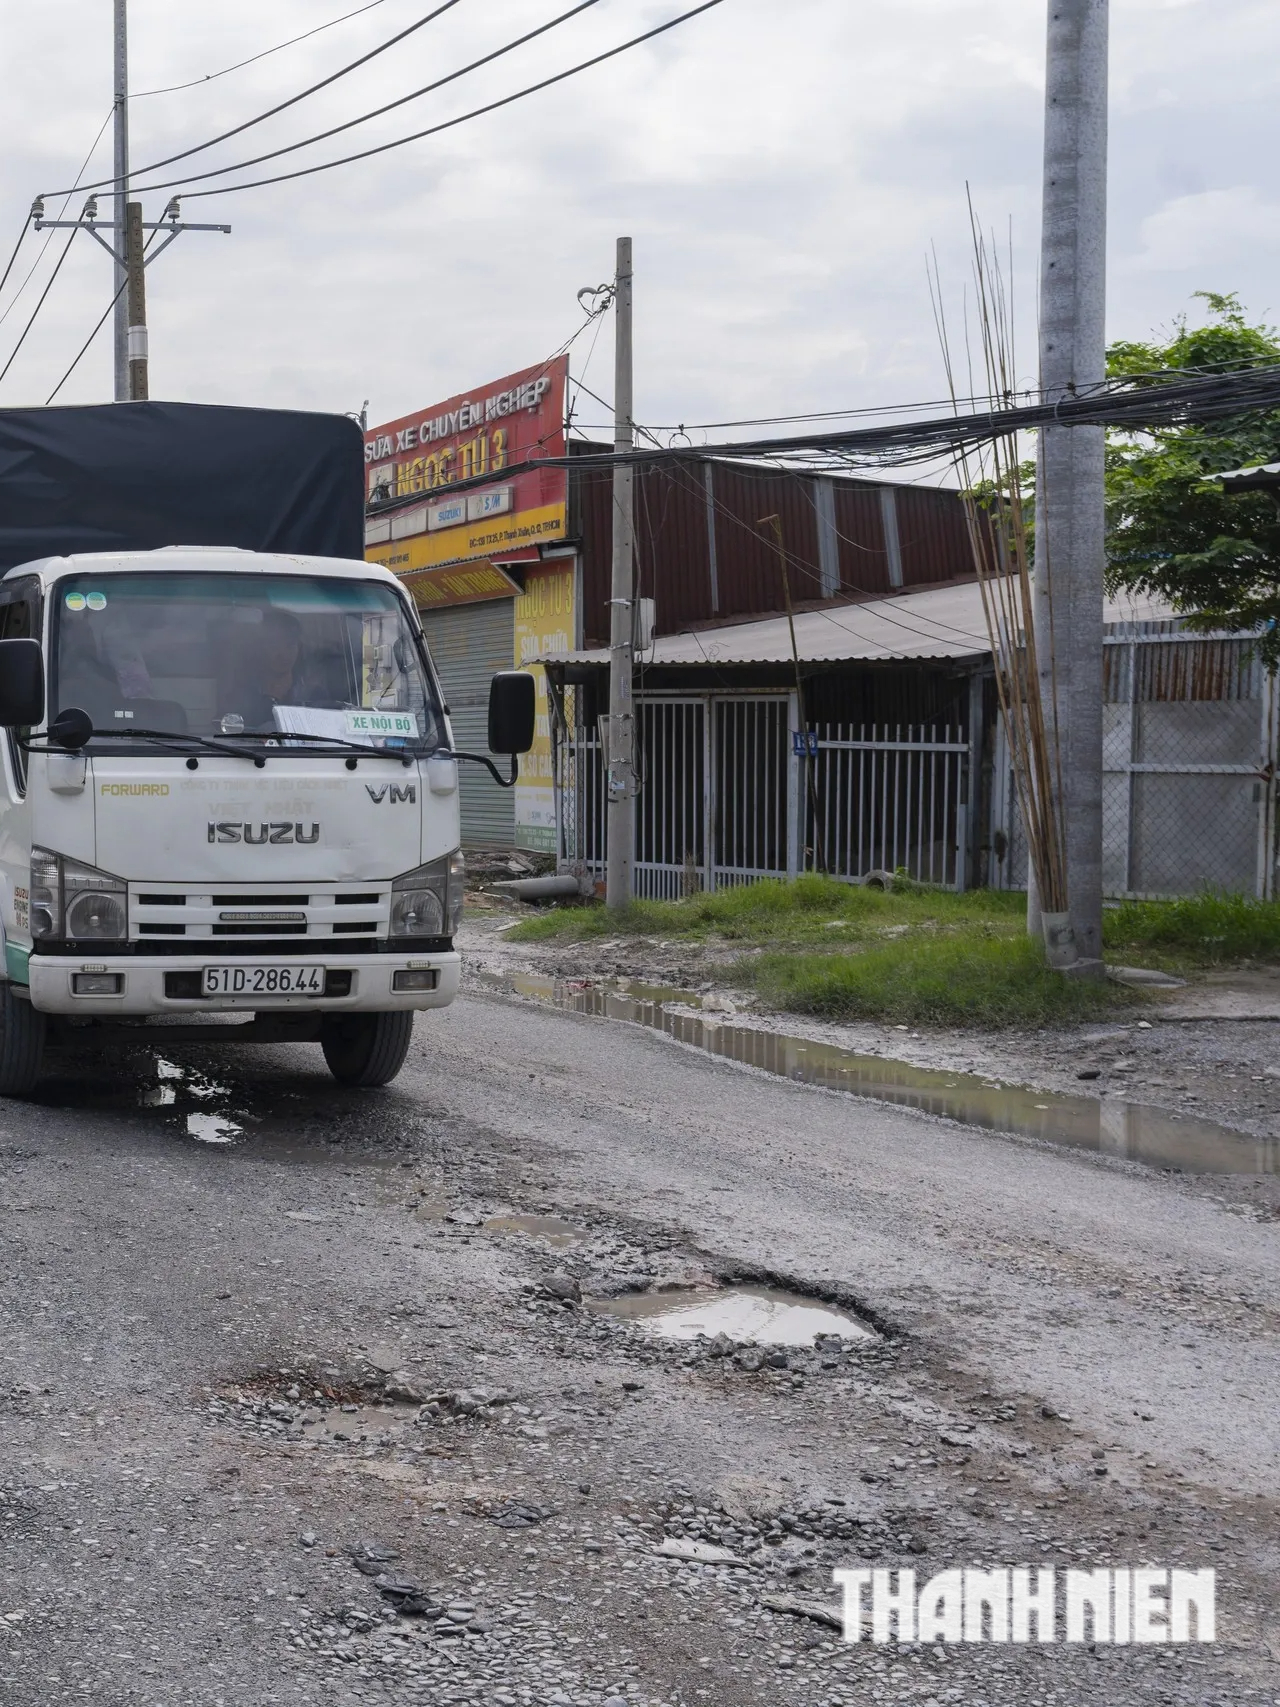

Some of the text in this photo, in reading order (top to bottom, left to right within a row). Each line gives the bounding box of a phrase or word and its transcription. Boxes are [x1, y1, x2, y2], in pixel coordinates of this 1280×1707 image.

[364, 377, 551, 463] SỬA XE CHUYÊN NGHIỆP
[458, 427, 488, 480] TÚ
[492, 428, 507, 471] 3
[438, 507, 462, 522] SUZUKI
[565, 572, 572, 615] 3
[352, 716, 411, 734] XE NỘI BỘ
[101, 783, 170, 797] FORWARD
[364, 783, 417, 804] VM
[207, 821, 320, 844] ISUZU
[207, 968, 320, 991] 51D-286.44
